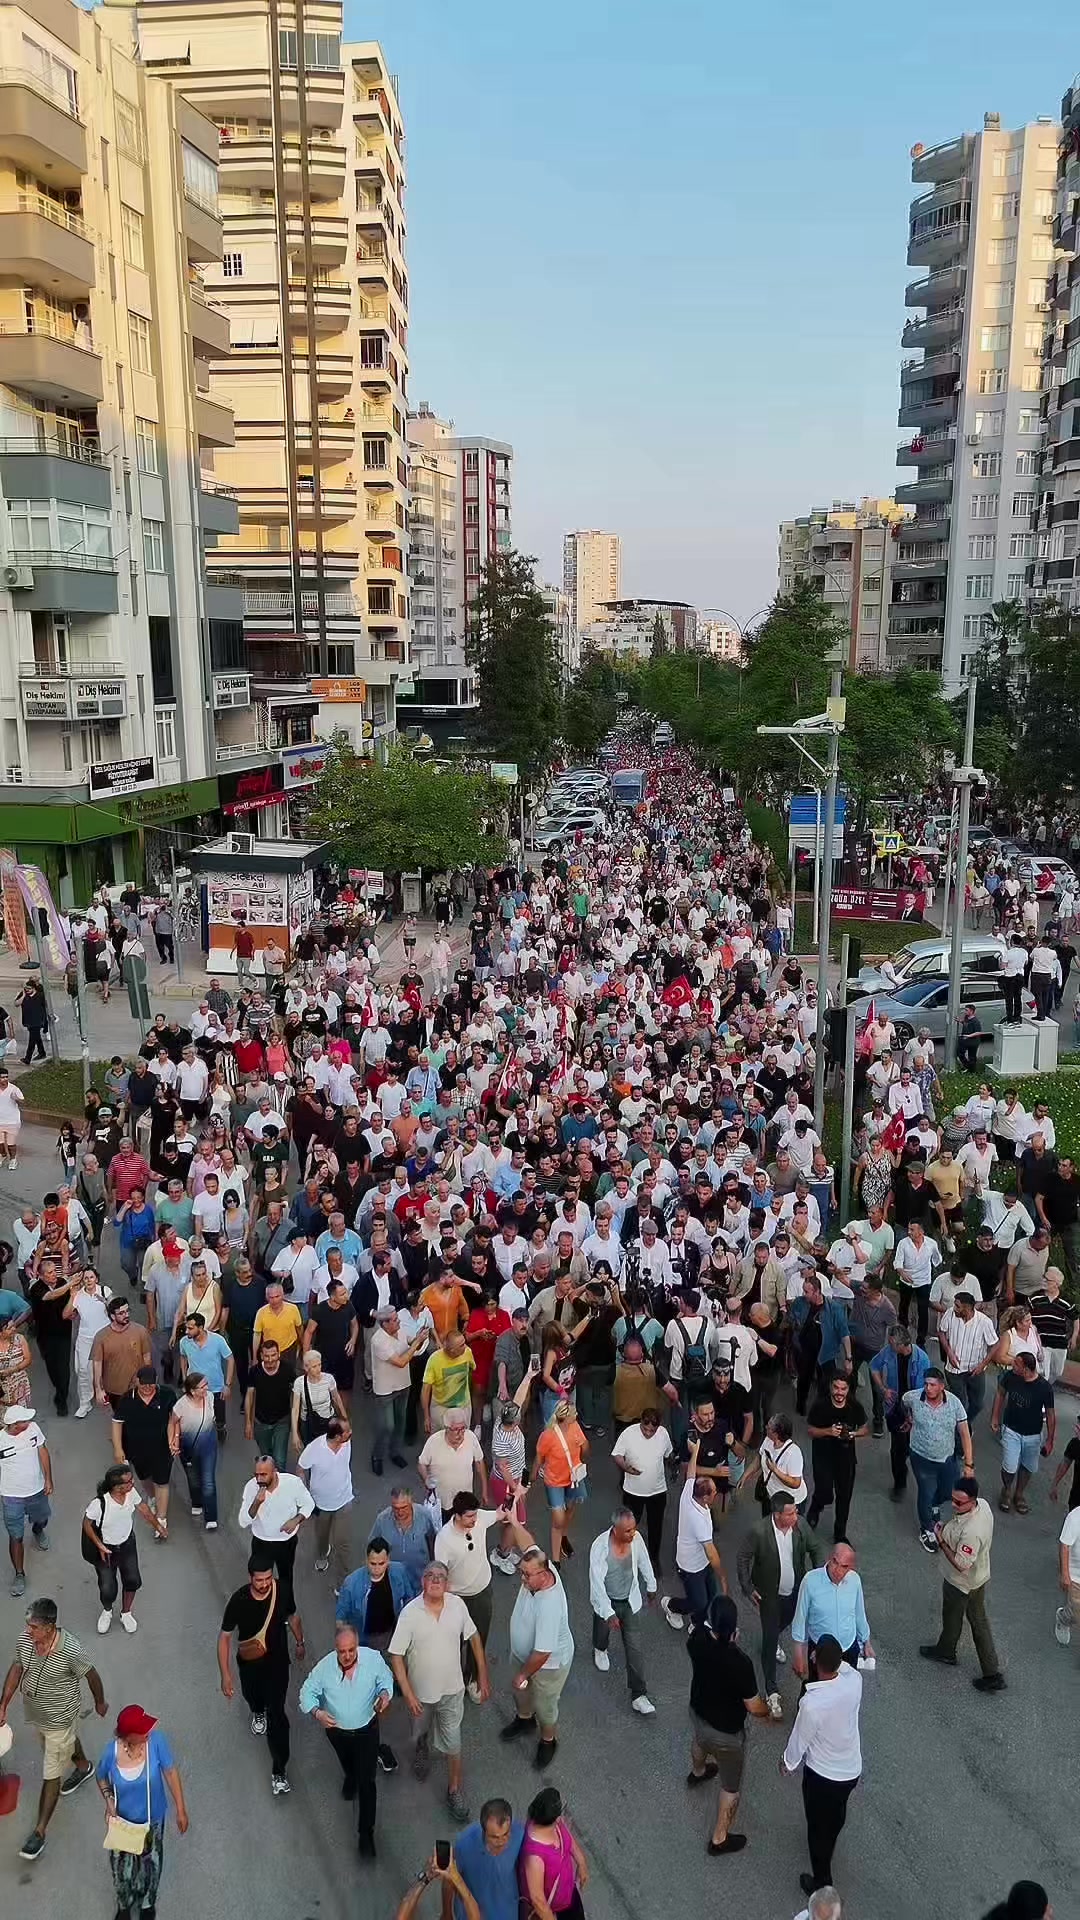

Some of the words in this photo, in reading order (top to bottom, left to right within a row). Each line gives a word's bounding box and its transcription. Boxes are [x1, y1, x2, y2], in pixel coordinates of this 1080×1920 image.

[25, 691, 39, 700] Diş
[40, 691, 66, 699] Hekimi
[85, 684, 97, 698] Diş
[98, 683, 121, 696] Hekimi
